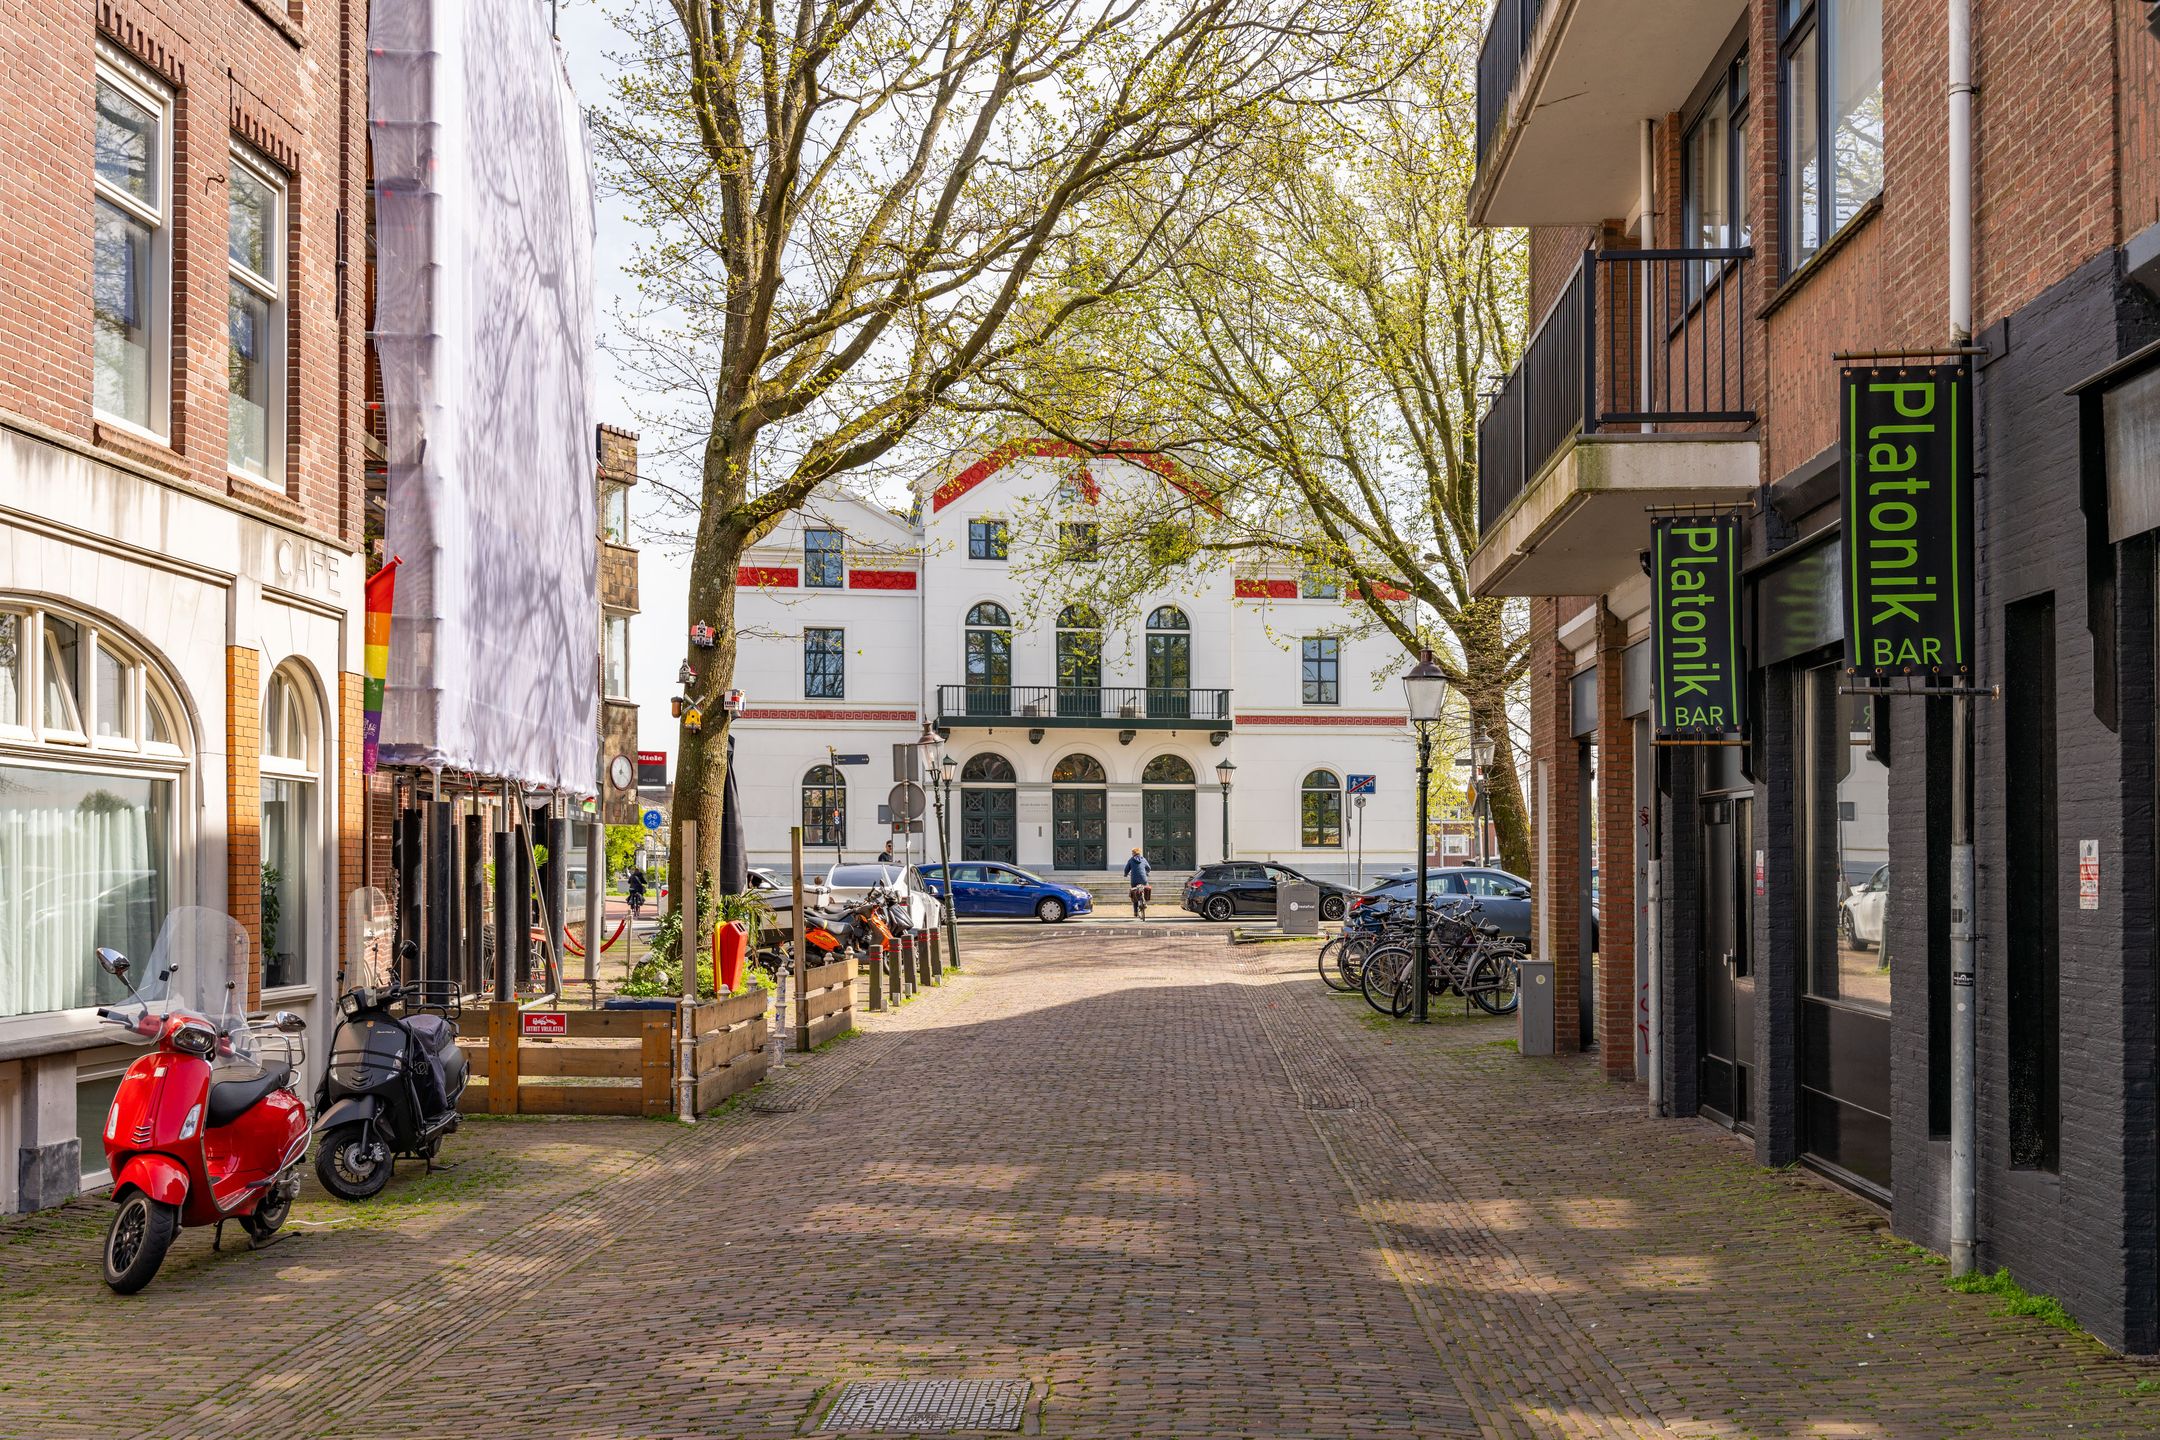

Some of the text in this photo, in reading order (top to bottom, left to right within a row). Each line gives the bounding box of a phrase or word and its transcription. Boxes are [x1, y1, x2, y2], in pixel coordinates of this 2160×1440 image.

[1869, 382, 1937, 626] Platonik
[275, 538, 341, 599] CAFE
[1671, 527, 1720, 698] Platonik
[1873, 637, 1943, 667] BAR
[1675, 706, 1724, 727] BAR
